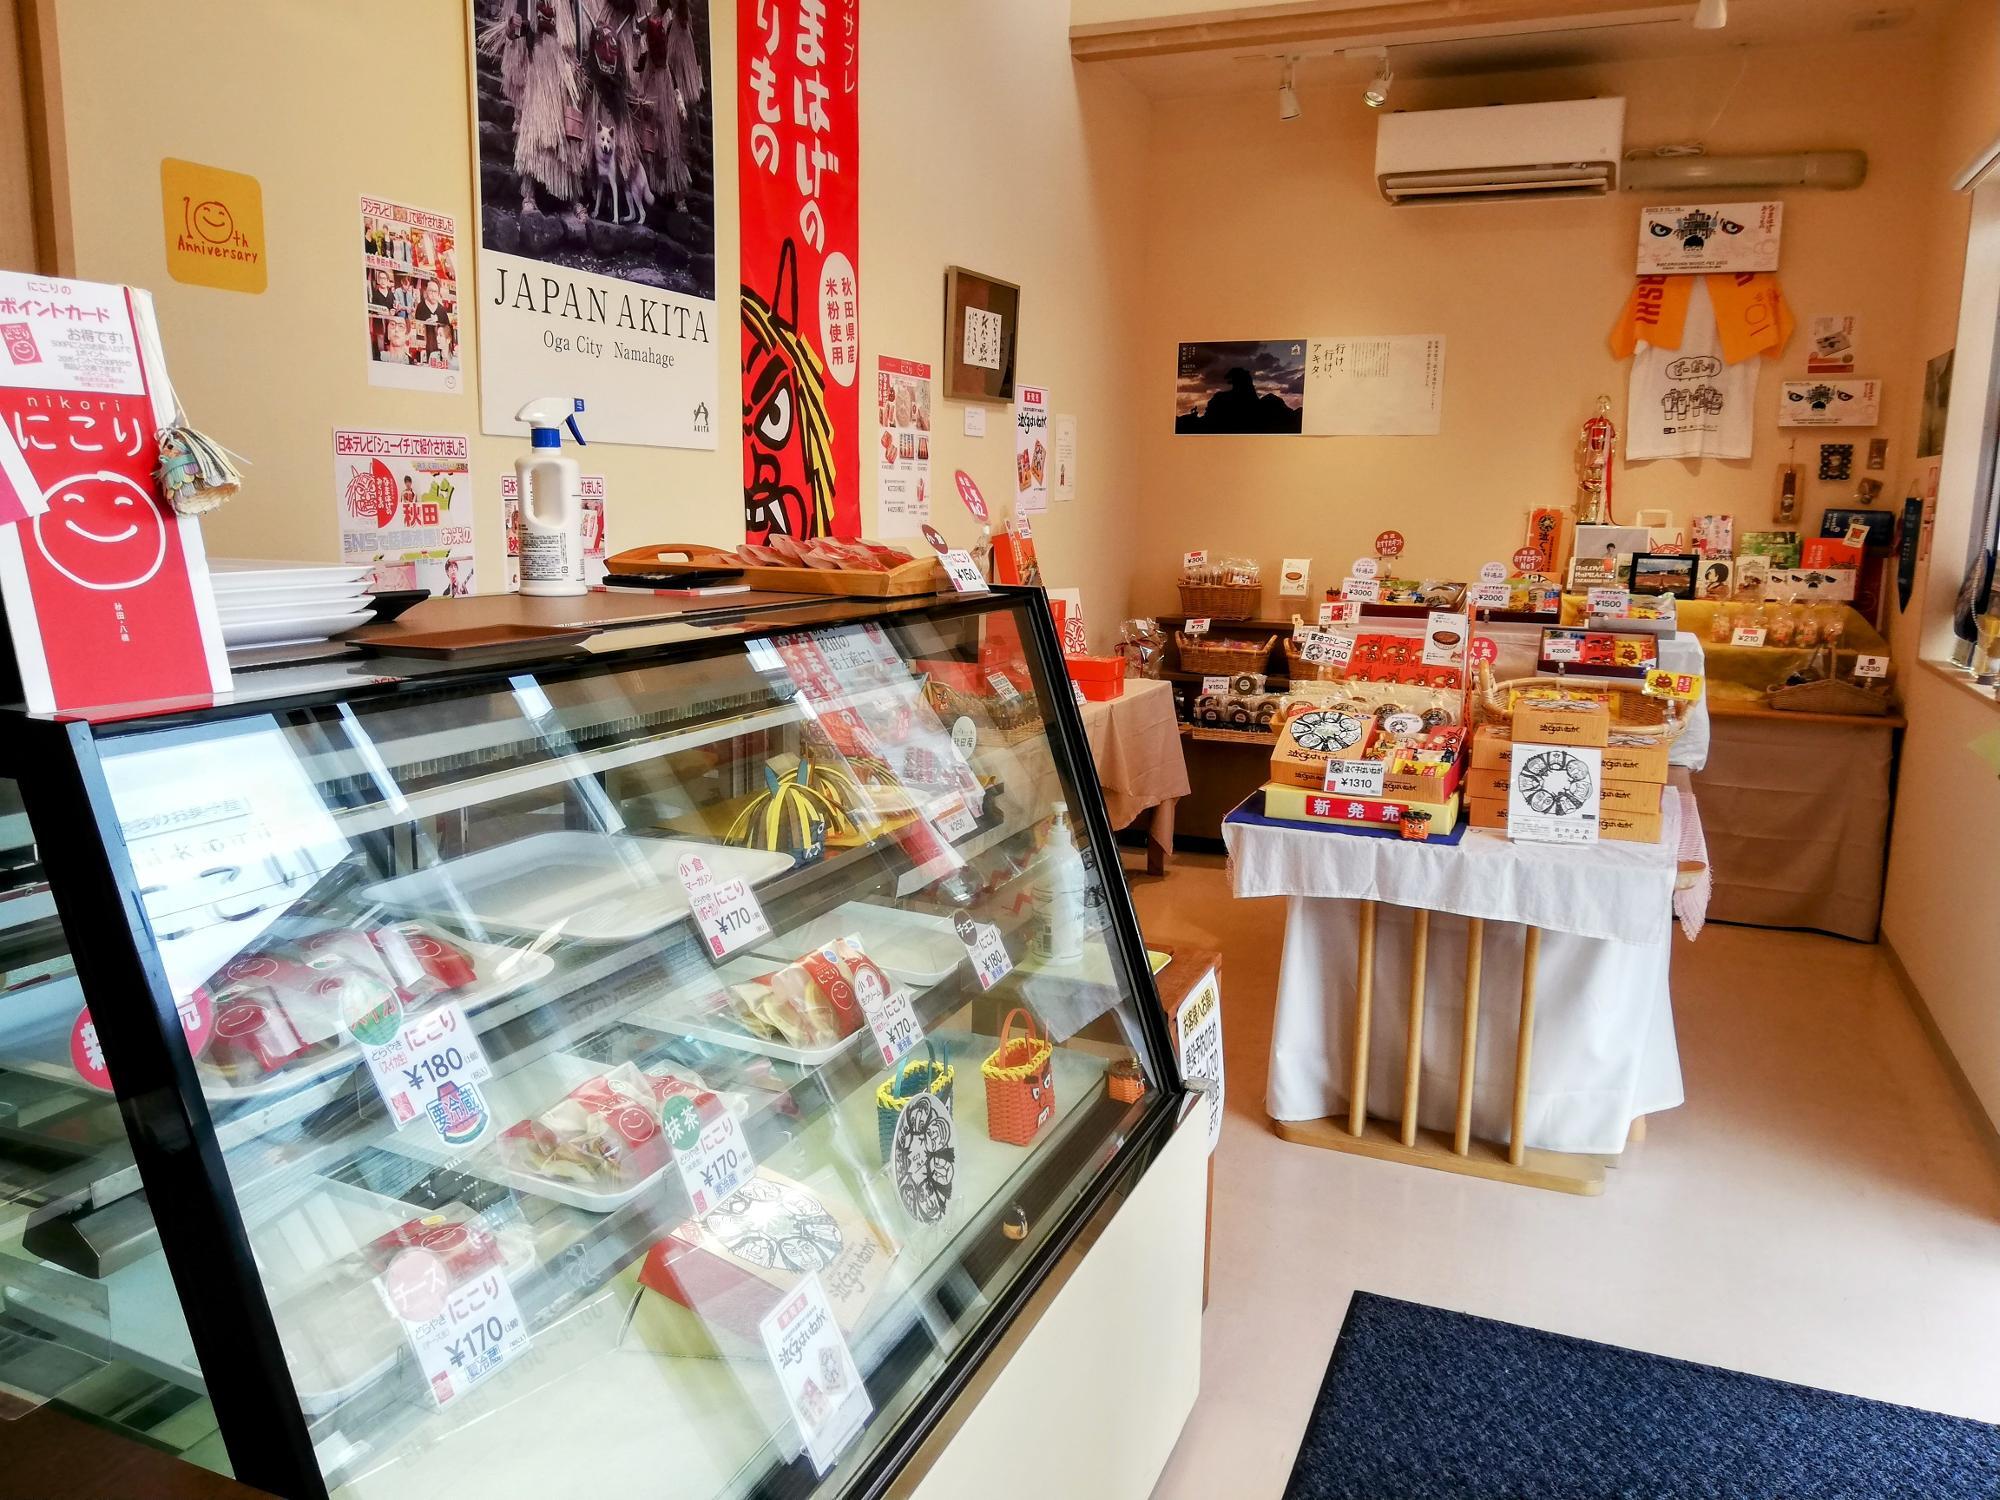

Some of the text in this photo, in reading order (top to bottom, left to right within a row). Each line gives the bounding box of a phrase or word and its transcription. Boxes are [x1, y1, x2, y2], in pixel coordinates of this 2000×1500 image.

[178, 234, 258, 264] Anniversary
[27, 281, 72, 296] にこりの
[1, 297, 110, 323] ポイントカード
[494, 268, 710, 344] JAPAN AKITA
[825, 277, 844, 365] 米粉使用
[841, 277, 855, 364] 秋田県産
[66, 328, 124, 344] お得です!
[543, 330, 675, 369] Oga City Namahage
[27, 395, 121, 411] nikori
[14, 412, 143, 457] にこり
[337, 435, 465, 456] 日本テレビ「シューイチ」で紹介されました
[402, 503, 439, 527] 秋田
[954, 568, 977, 582] ¥150
[1349, 588, 1373, 597] ¥3000
[1595, 600, 1622, 608] ¥1500
[1324, 648, 1348, 660] ¥130
[1859, 665, 1881, 673] ¥330
[1340, 777, 1372, 789] ¥1310
[1313, 798, 1400, 822] 新発売
[684, 873, 713, 891] マーガリン
[713, 880, 745, 906] にこり
[715, 907, 751, 936] ¥170
[956, 919, 974, 938] チョコ
[978, 929, 997, 950] にこり
[982, 950, 1003, 972] ¥180
[817, 967, 839, 985] にこり
[883, 993, 906, 1019] にこり
[404, 1010, 457, 1051] にこり
[885, 1018, 911, 1044] ¥170
[371, 1040, 403, 1062] どらやき
[402, 1047, 463, 1090] ¥180
[664, 1104, 700, 1145] 抹茶
[701, 1117, 734, 1154] にこり
[700, 1148, 738, 1188] ¥170
[449, 1275, 499, 1325] にこり
[445, 1316, 503, 1368] ¥170
